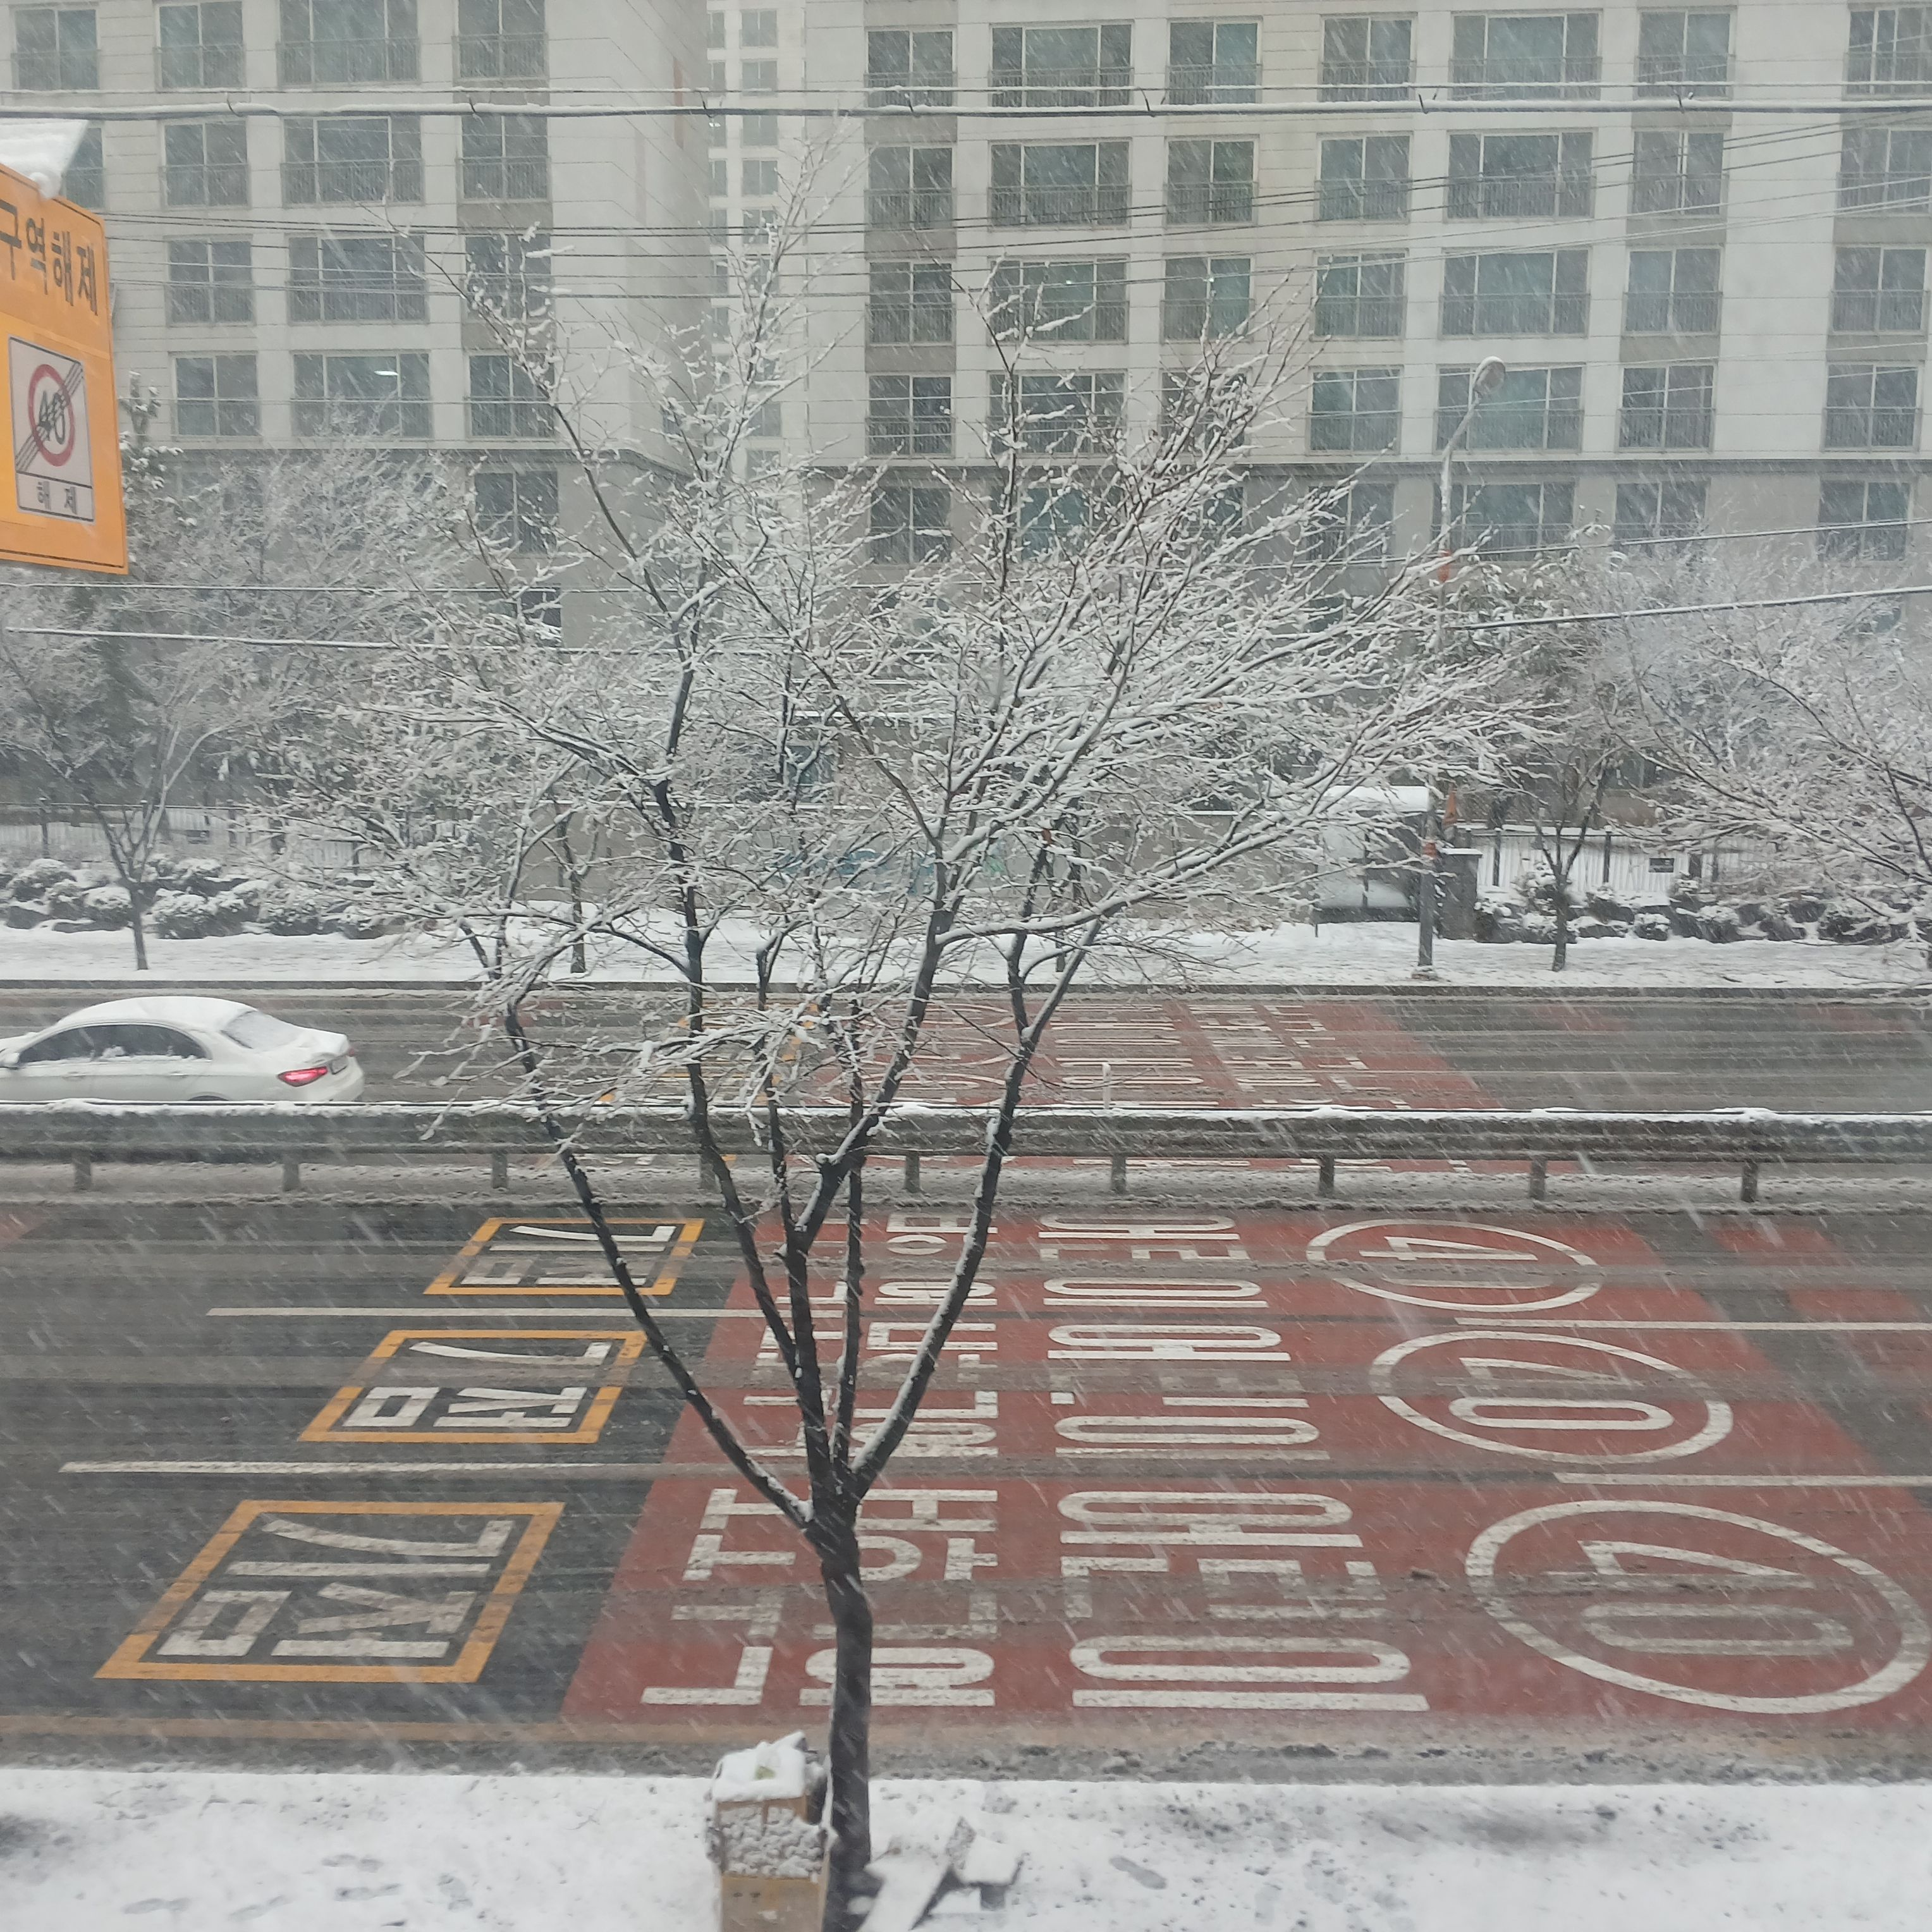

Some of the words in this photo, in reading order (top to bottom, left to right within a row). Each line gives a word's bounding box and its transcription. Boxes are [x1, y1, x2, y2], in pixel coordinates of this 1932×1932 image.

[0, 200, 99, 315] 구역해제
[39, 389, 66, 445] 40
[461, 1226, 676, 1286] 기점
[1037, 1214, 1269, 1308] 어린이
[1359, 1236, 1549, 1289] 40
[342, 1341, 612, 1427] 기점
[1046, 1324, 1330, 1460] 어린이
[1436, 1358, 1675, 1430] 40
[157, 1520, 515, 1657] 기점
[1055, 1491, 1429, 1711] 어린이
[1542, 1541, 1857, 1656] 40
